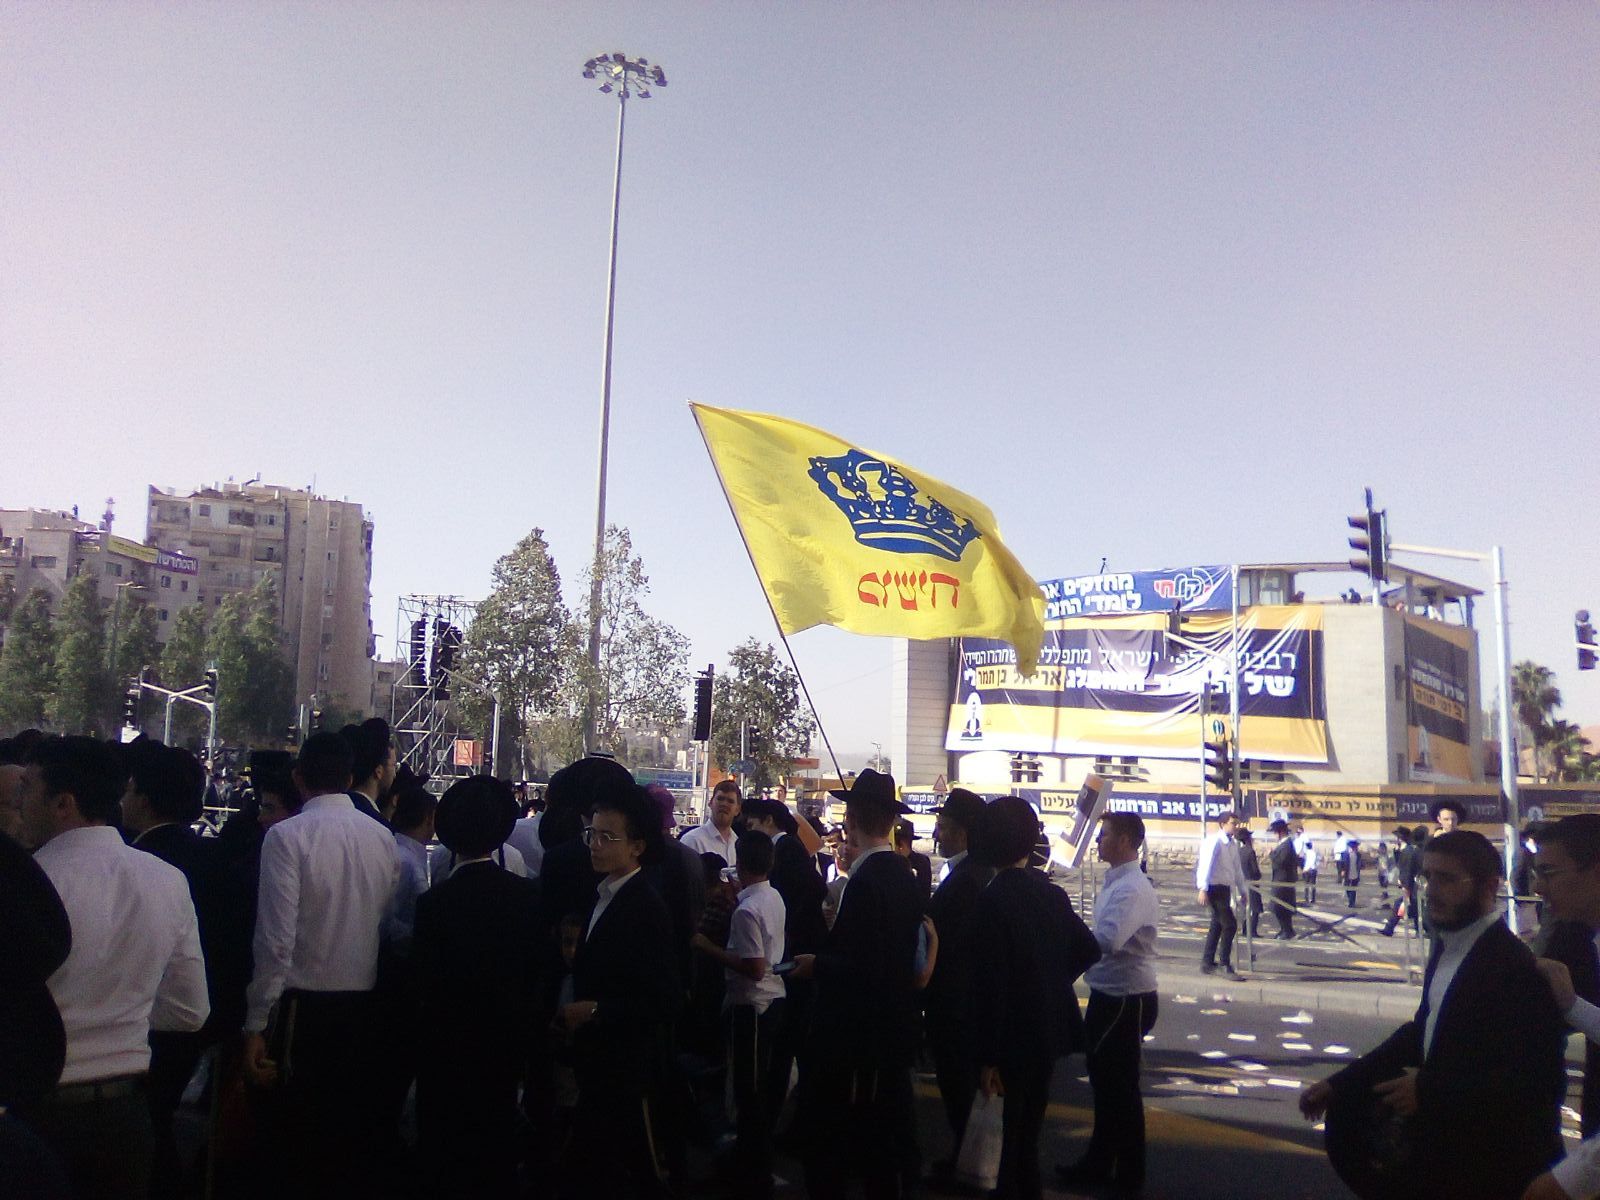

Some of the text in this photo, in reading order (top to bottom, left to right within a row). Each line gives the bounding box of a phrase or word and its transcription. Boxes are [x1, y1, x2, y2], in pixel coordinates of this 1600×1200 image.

[1064, 573, 1134, 597] מחזקים
[1084, 591, 1143, 612] לומדי
[1037, 646, 1091, 664] מתפללי
[1098, 646, 1160, 667] ישראל
[997, 669, 1006, 685] בן
[1244, 671, 1294, 696] של
[1043, 795, 1073, 809] עלינו
[1106, 798, 1158, 814] הרחמן
[1163, 801, 1185, 815] אב
